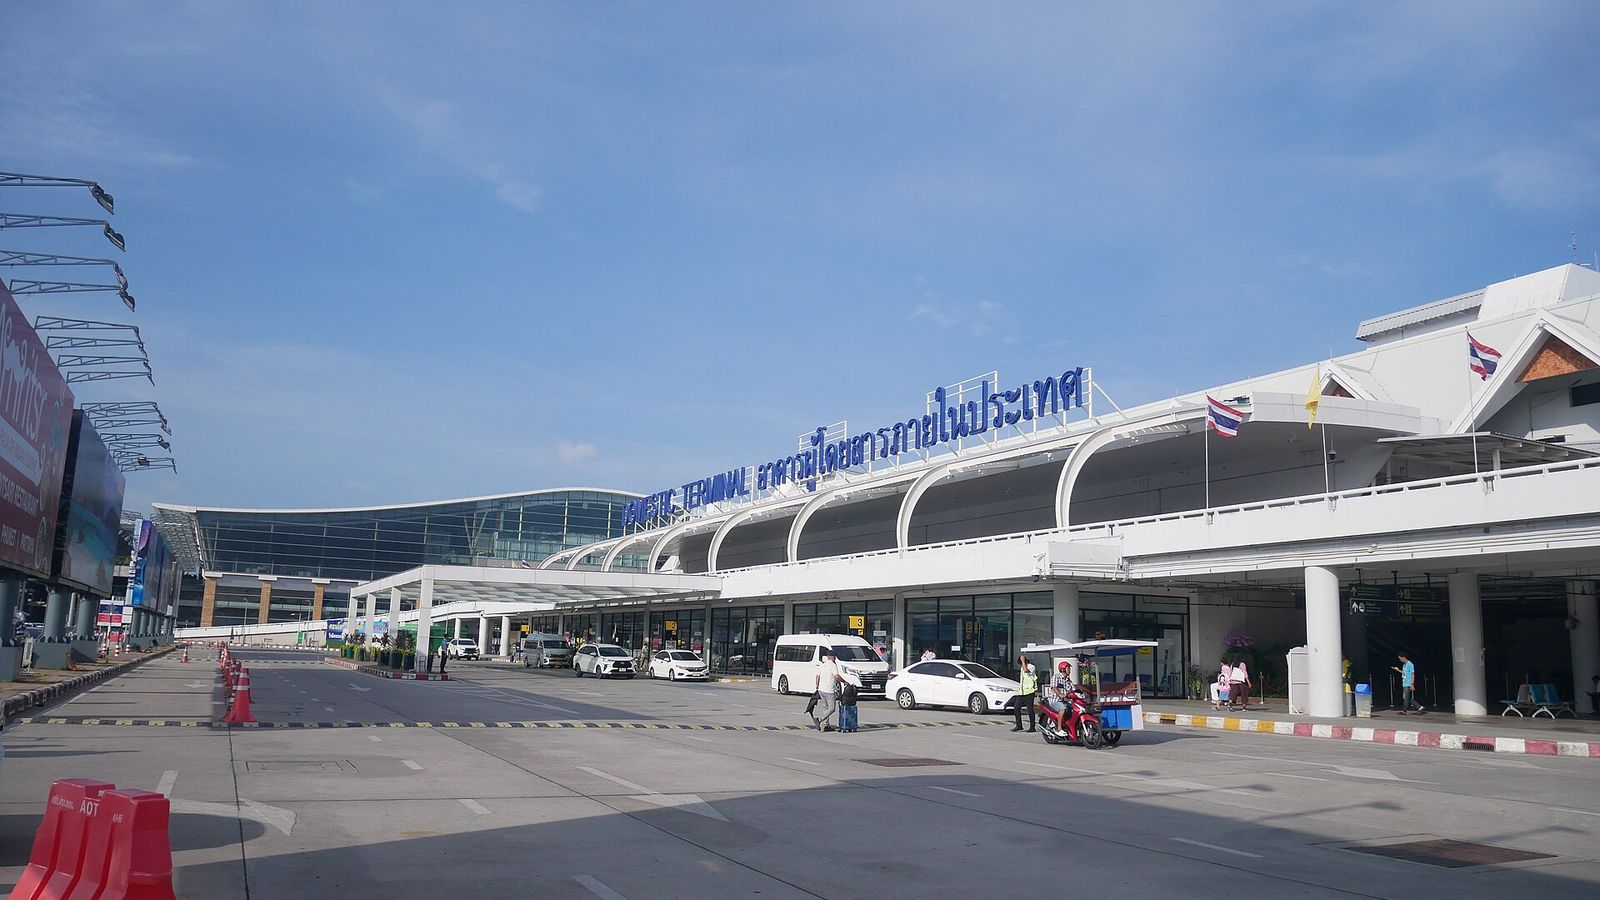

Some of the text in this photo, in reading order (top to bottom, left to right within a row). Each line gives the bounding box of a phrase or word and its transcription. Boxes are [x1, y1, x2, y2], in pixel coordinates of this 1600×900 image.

[622, 467, 749, 526] DOMESTIC TERMINAL
[79, 800, 99, 817] AOT
